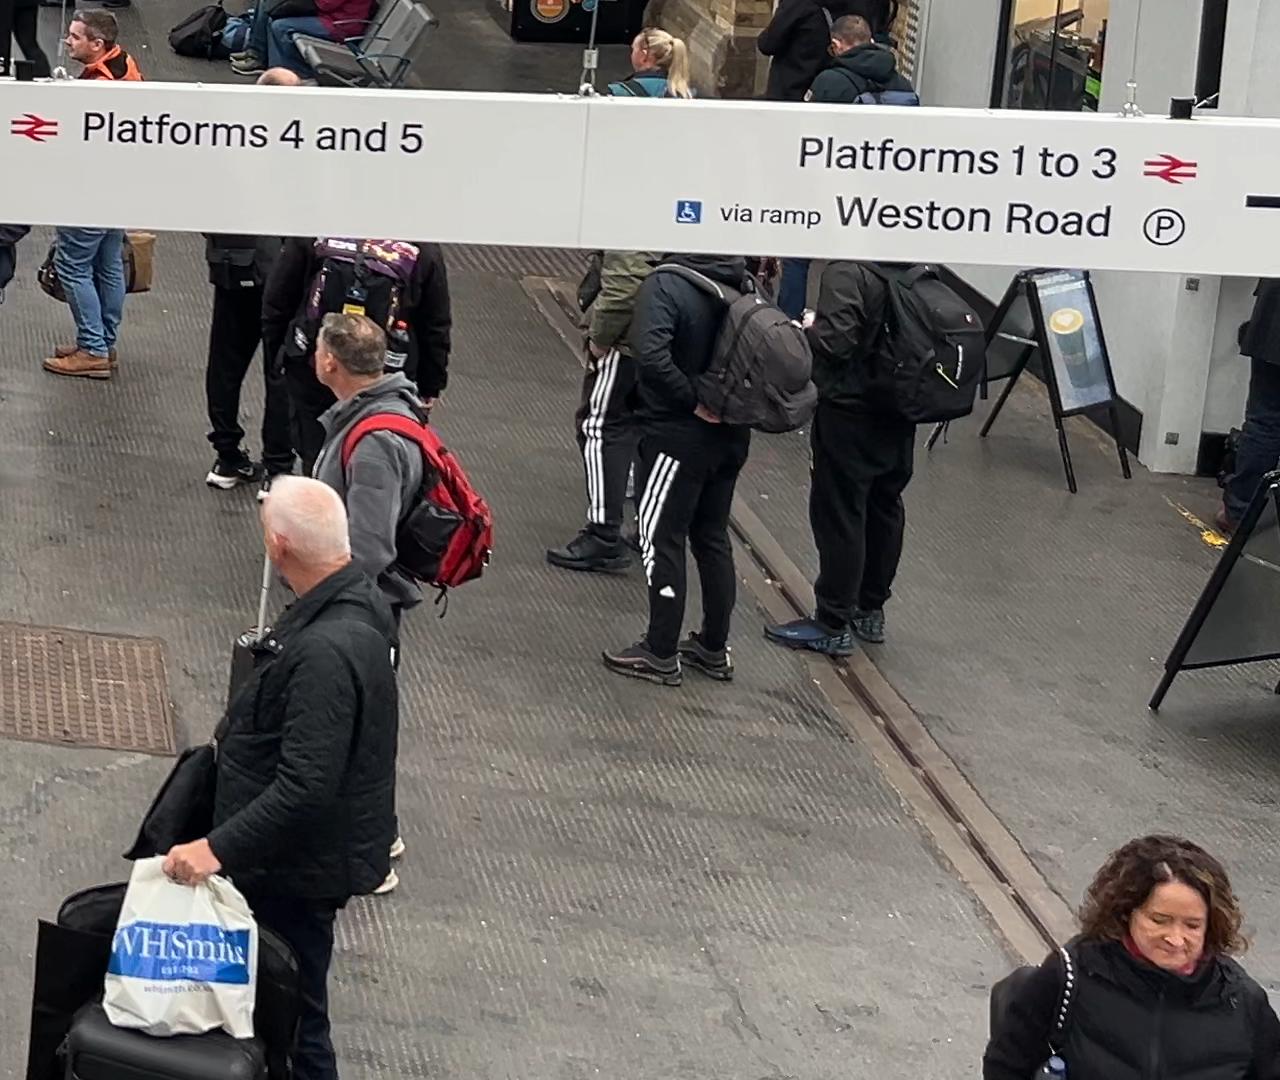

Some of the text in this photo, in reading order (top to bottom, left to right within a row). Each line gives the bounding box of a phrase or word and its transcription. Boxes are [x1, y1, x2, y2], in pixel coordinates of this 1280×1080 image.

[83, 111, 423, 154] Platforms 4 and 5
[799, 136, 1117, 179] Platforms 1 to 3
[720, 203, 821, 230] via ramp
[836, 196, 1112, 237] Weston Road
[1155, 215, 1175, 239] P
